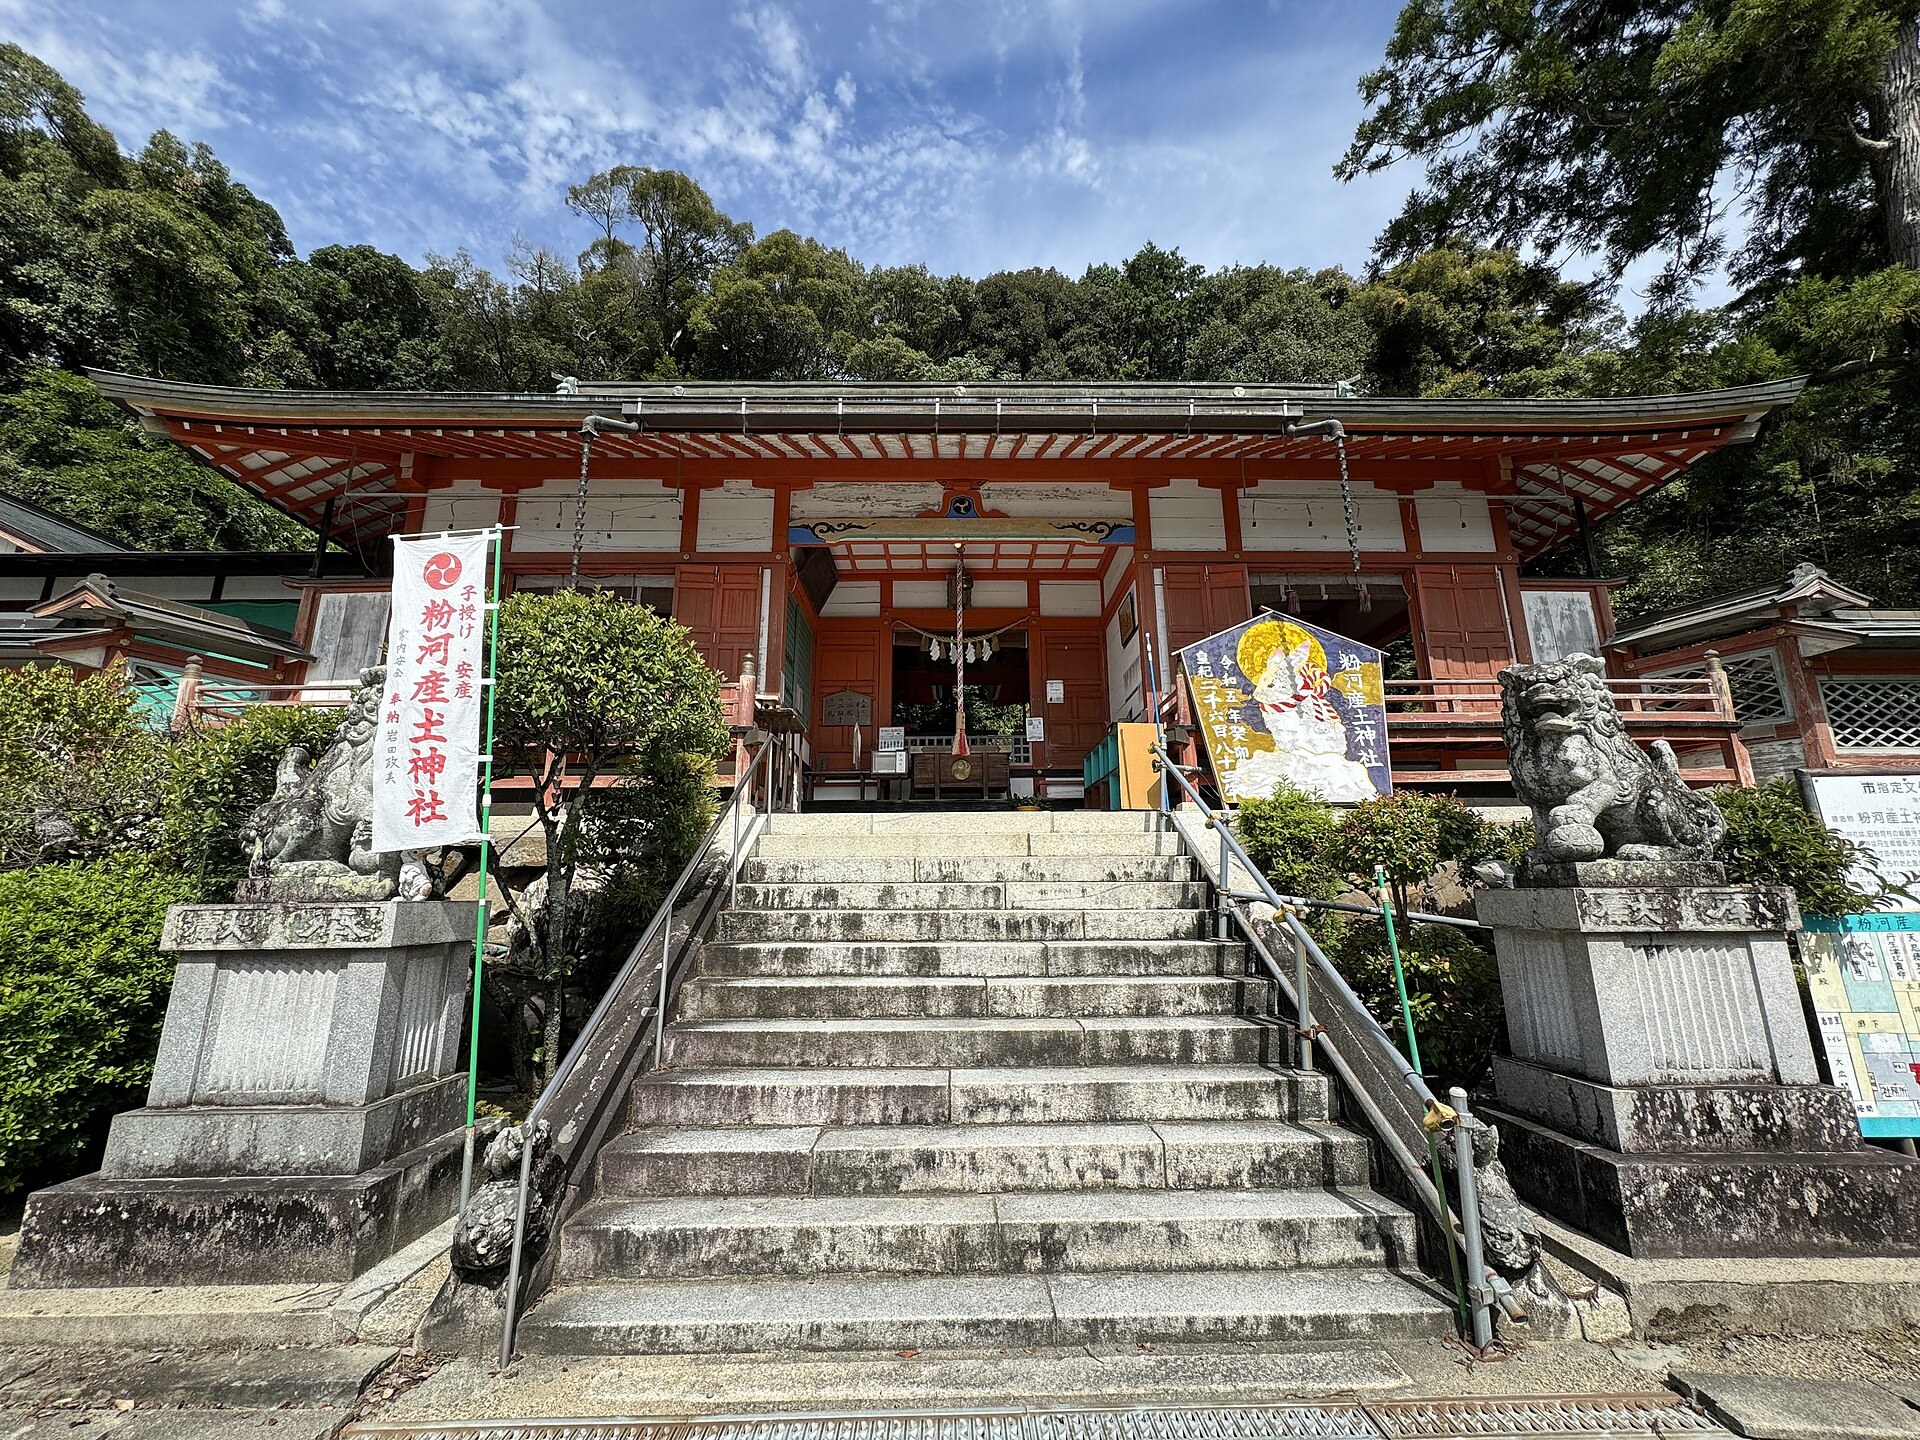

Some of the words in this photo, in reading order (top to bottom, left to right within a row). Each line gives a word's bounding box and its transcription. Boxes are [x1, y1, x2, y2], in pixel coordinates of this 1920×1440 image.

[393, 628, 409, 678] 家内安全
[454, 585, 477, 699] 子授け・安産
[386, 692, 402, 723] 奉納
[1219, 654, 1249, 760] 令和五年癸卯
[1339, 650, 1384, 768] 粉河産土神社
[1861, 782, 1920, 794] 市指定文
